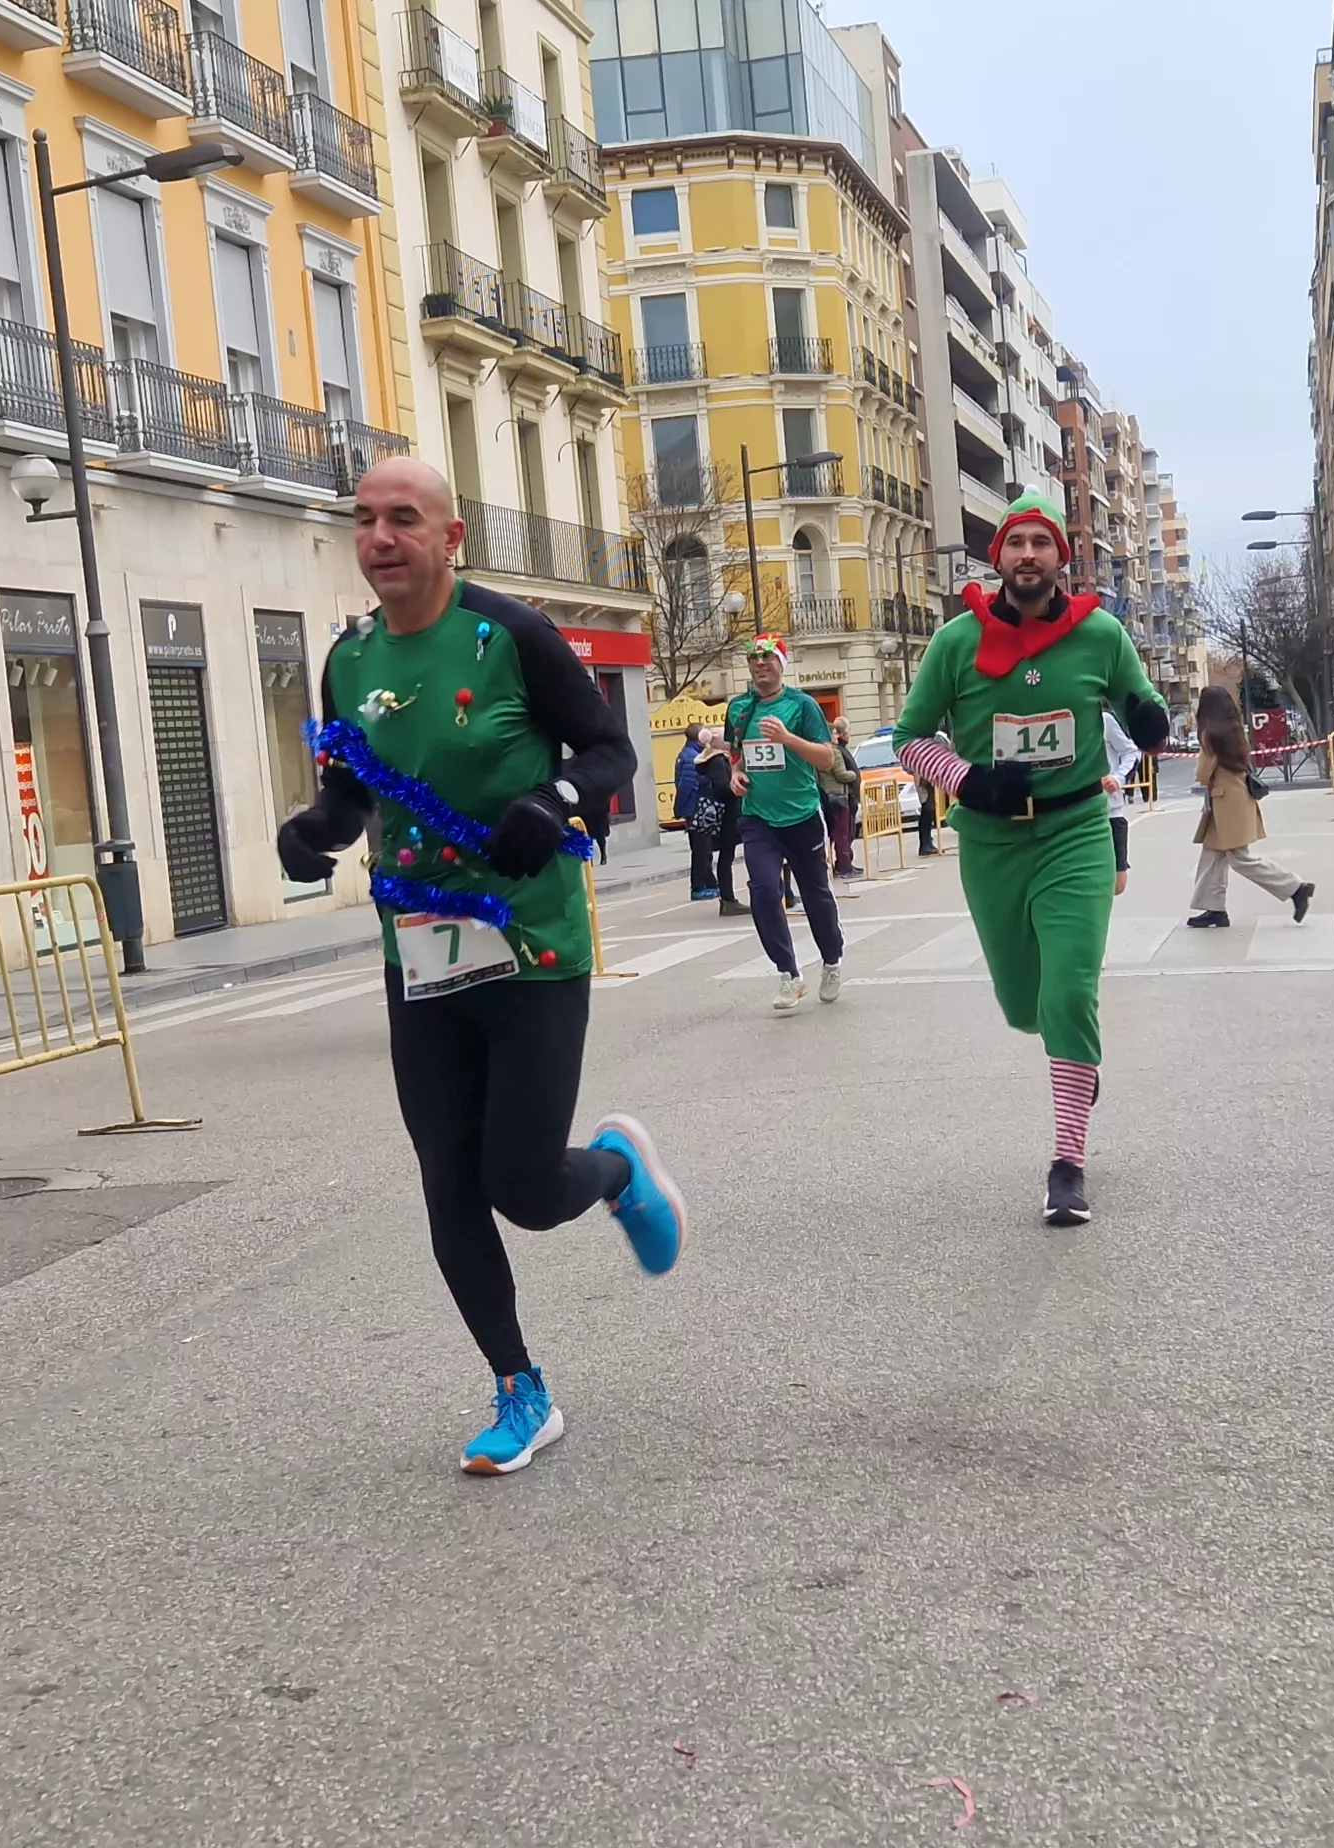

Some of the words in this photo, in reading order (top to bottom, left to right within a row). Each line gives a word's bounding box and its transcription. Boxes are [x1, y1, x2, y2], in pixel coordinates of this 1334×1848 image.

[0, 608, 33, 634] Pilar
[36, 610, 71, 636] Prieto
[754, 745, 776, 762] 53
[1017, 724, 1060, 754] 14
[432, 923, 460, 966] 7
